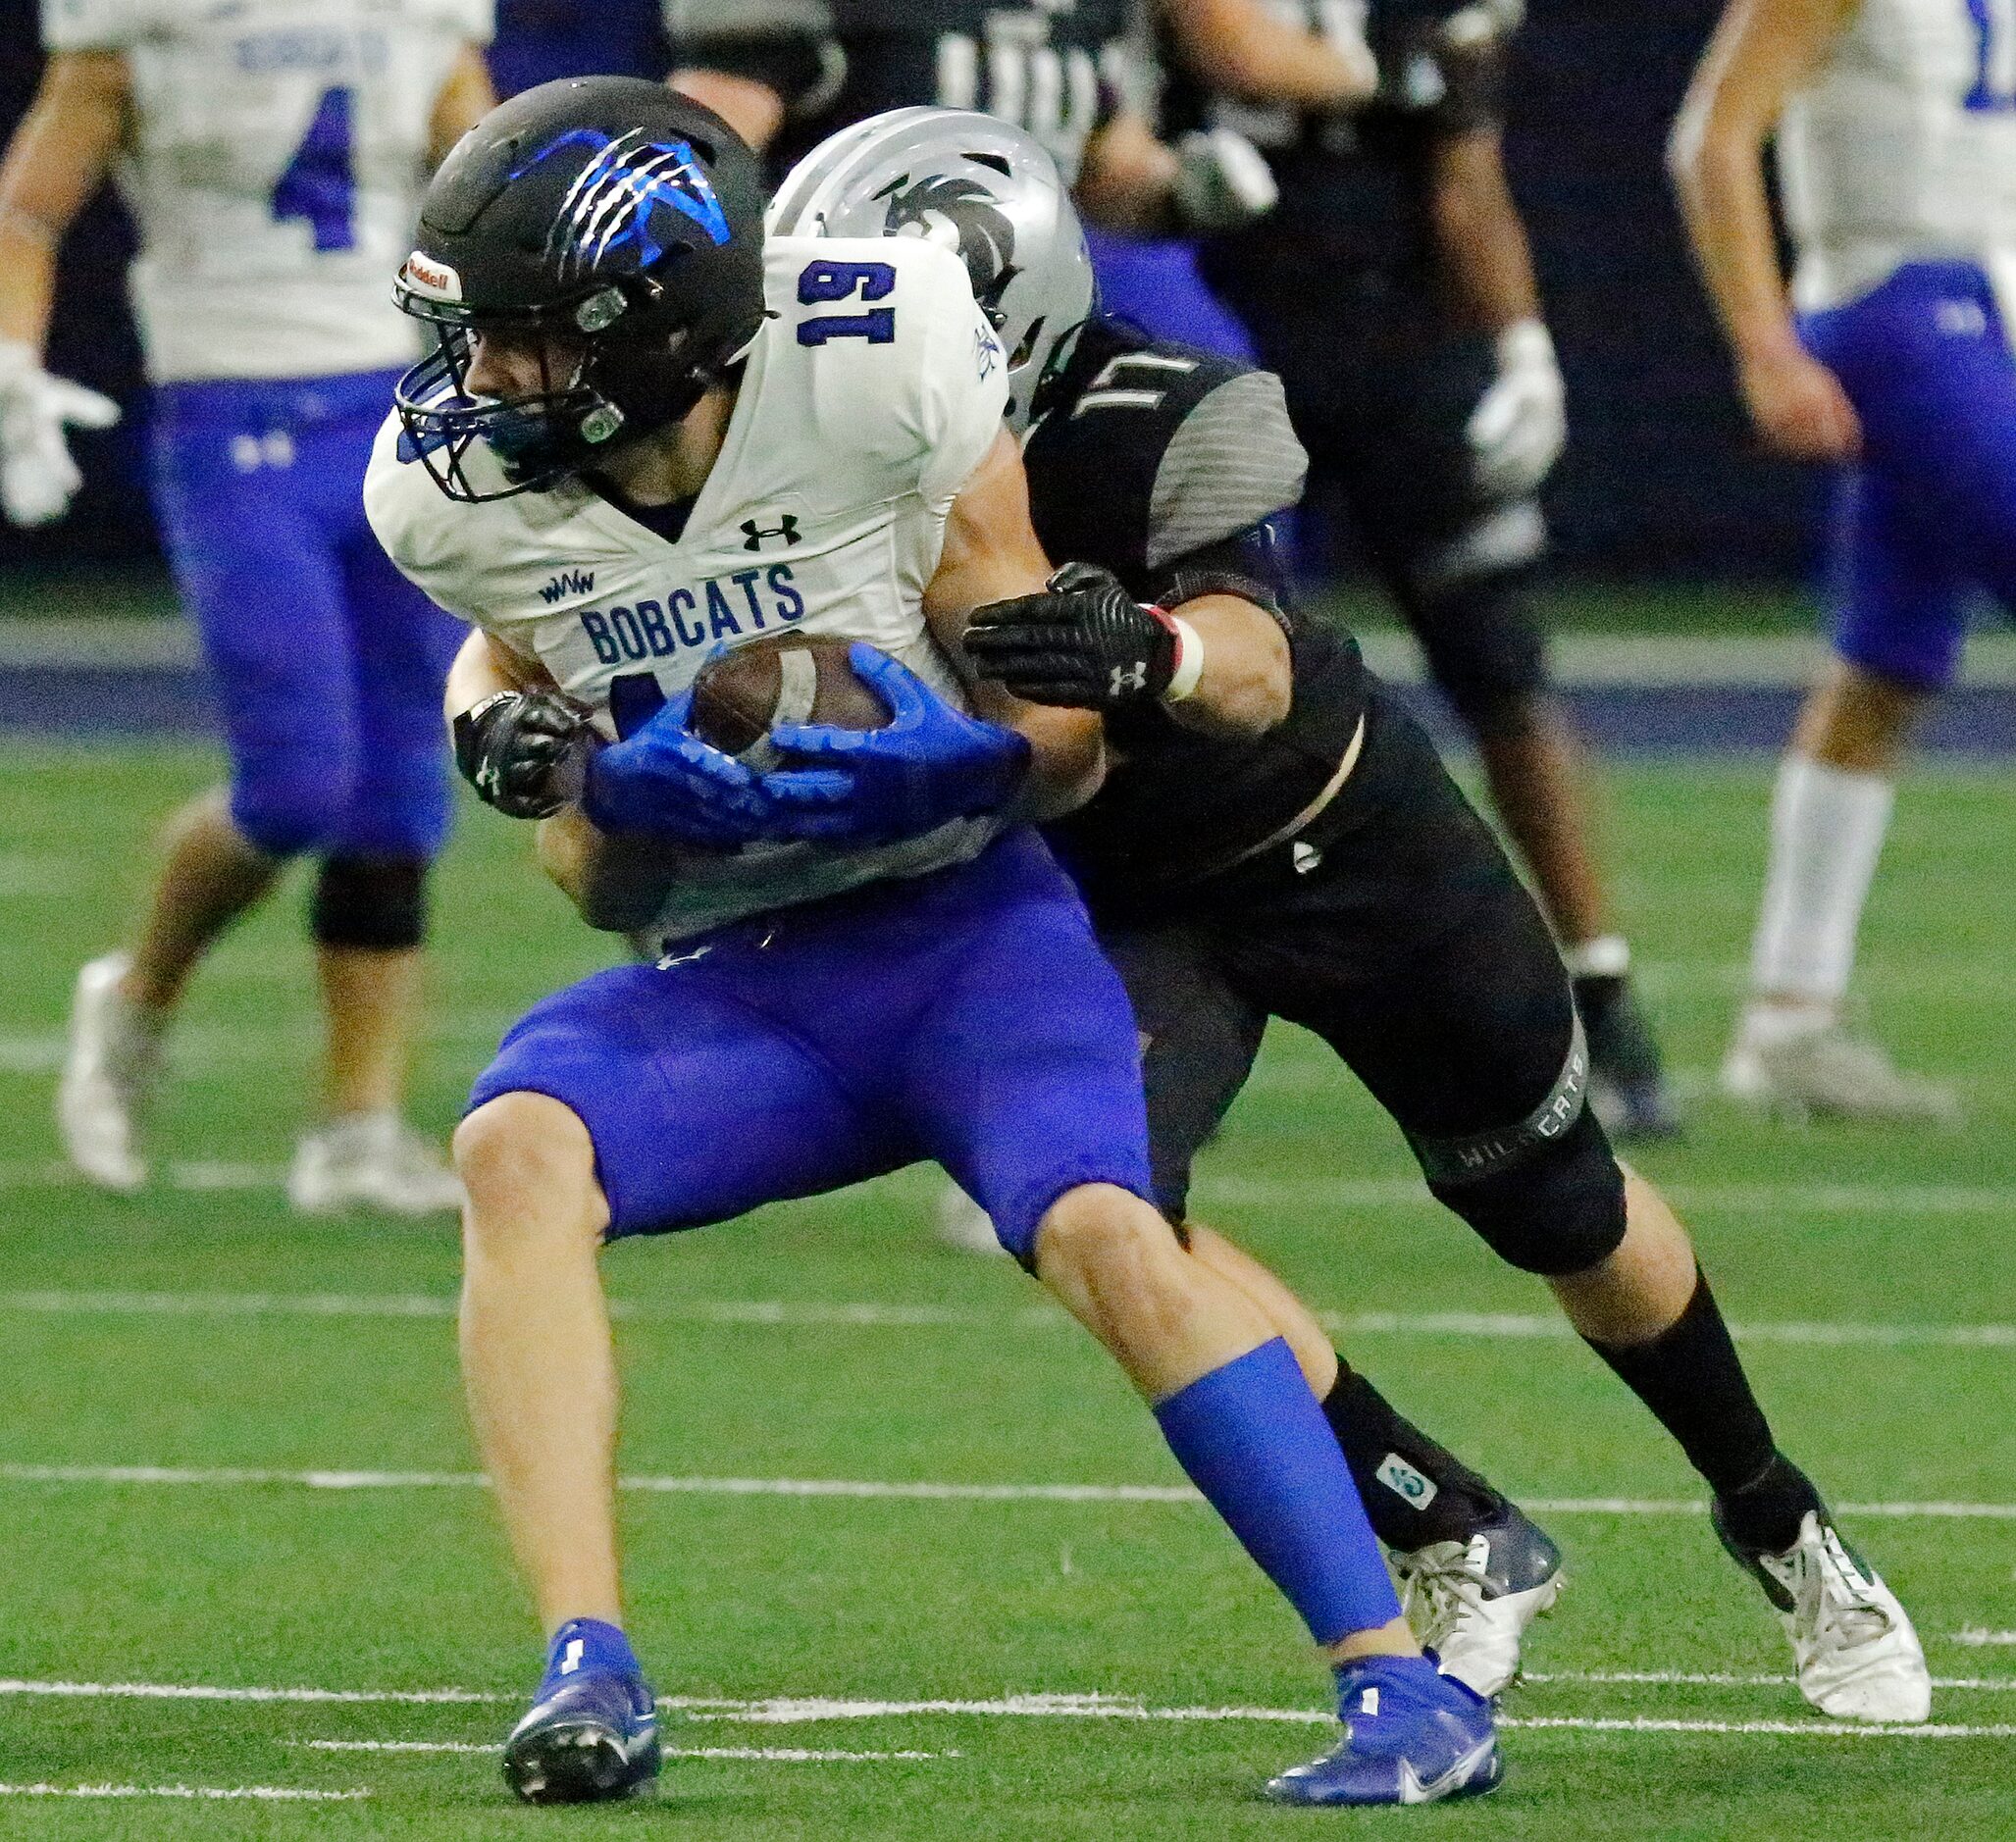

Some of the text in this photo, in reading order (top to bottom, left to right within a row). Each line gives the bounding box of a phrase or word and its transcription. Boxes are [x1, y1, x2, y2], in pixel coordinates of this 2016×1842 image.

[271, 83, 356, 251] 4
[797, 259, 897, 347] 19
[580, 563, 804, 664] BOBCATS
